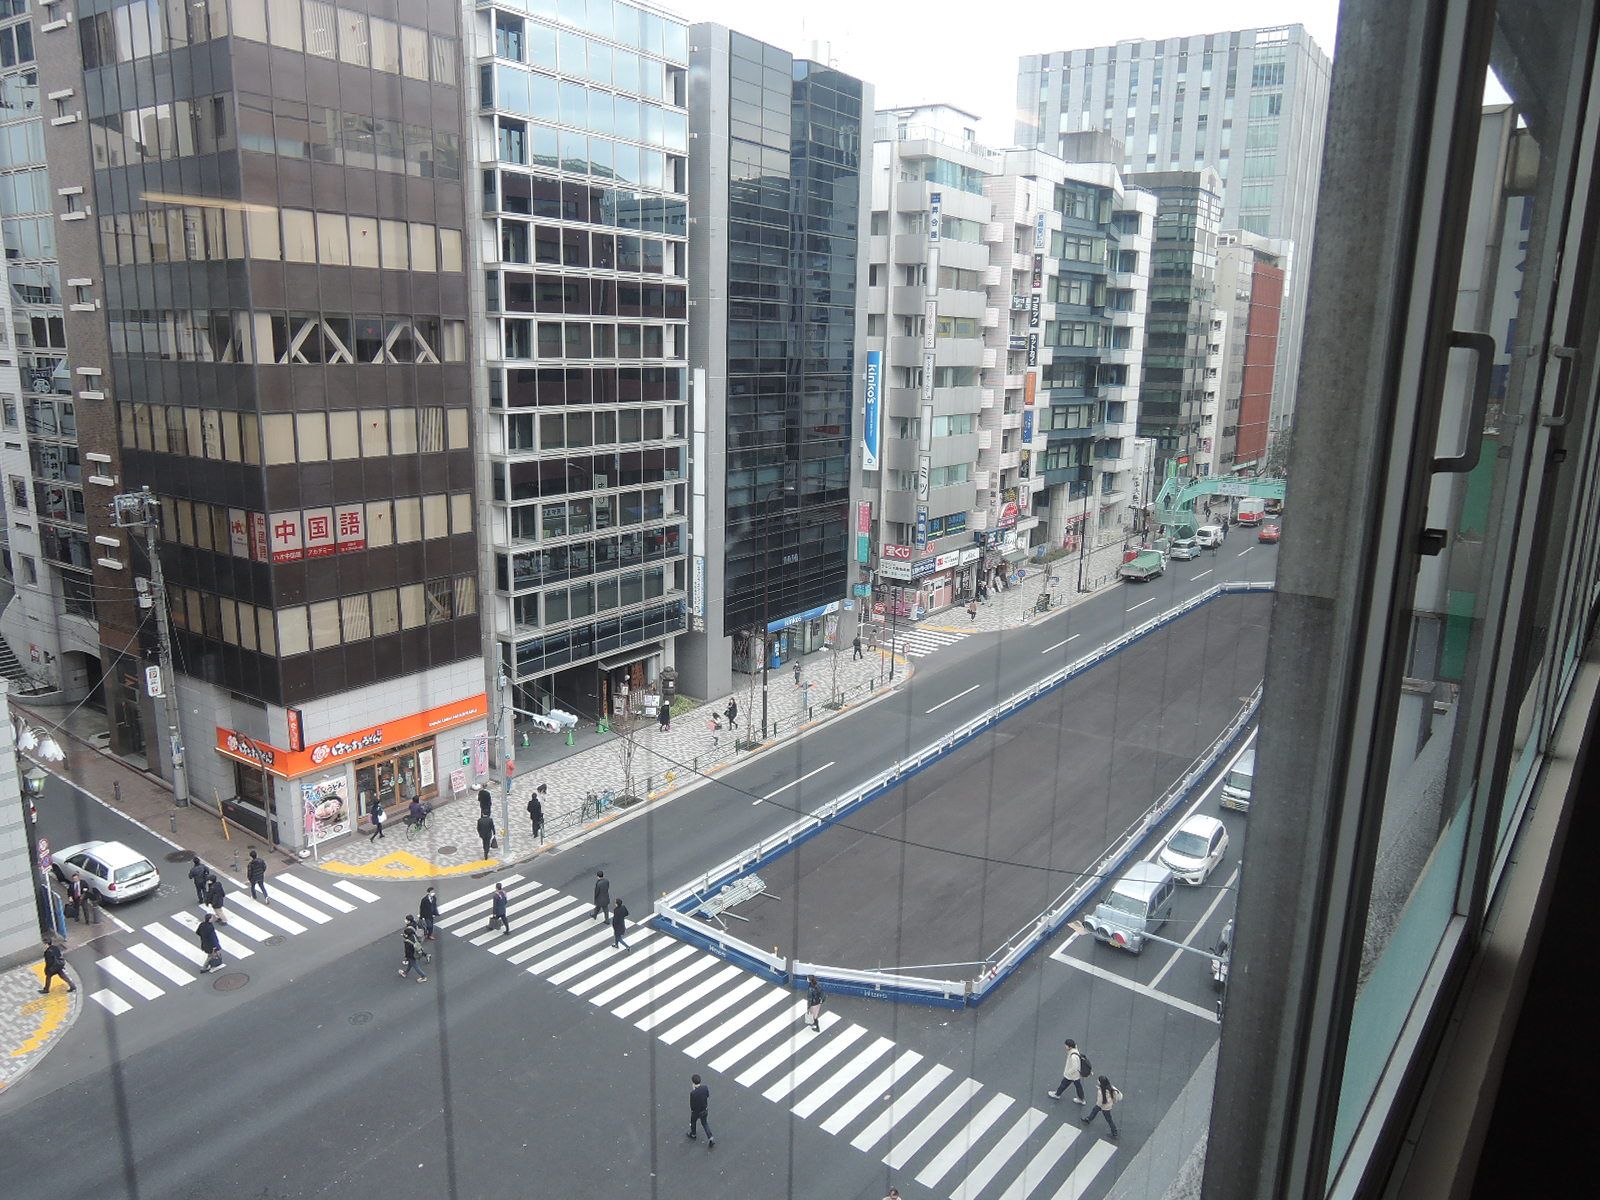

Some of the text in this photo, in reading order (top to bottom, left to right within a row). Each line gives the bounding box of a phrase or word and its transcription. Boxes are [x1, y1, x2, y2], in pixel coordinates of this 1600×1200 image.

[1031, 296, 1039, 325] コミック
[1029, 334, 1037, 366] ネットカフェ
[275, 511, 360, 544] 中国語
[885, 544, 910, 558] 宝くじ
